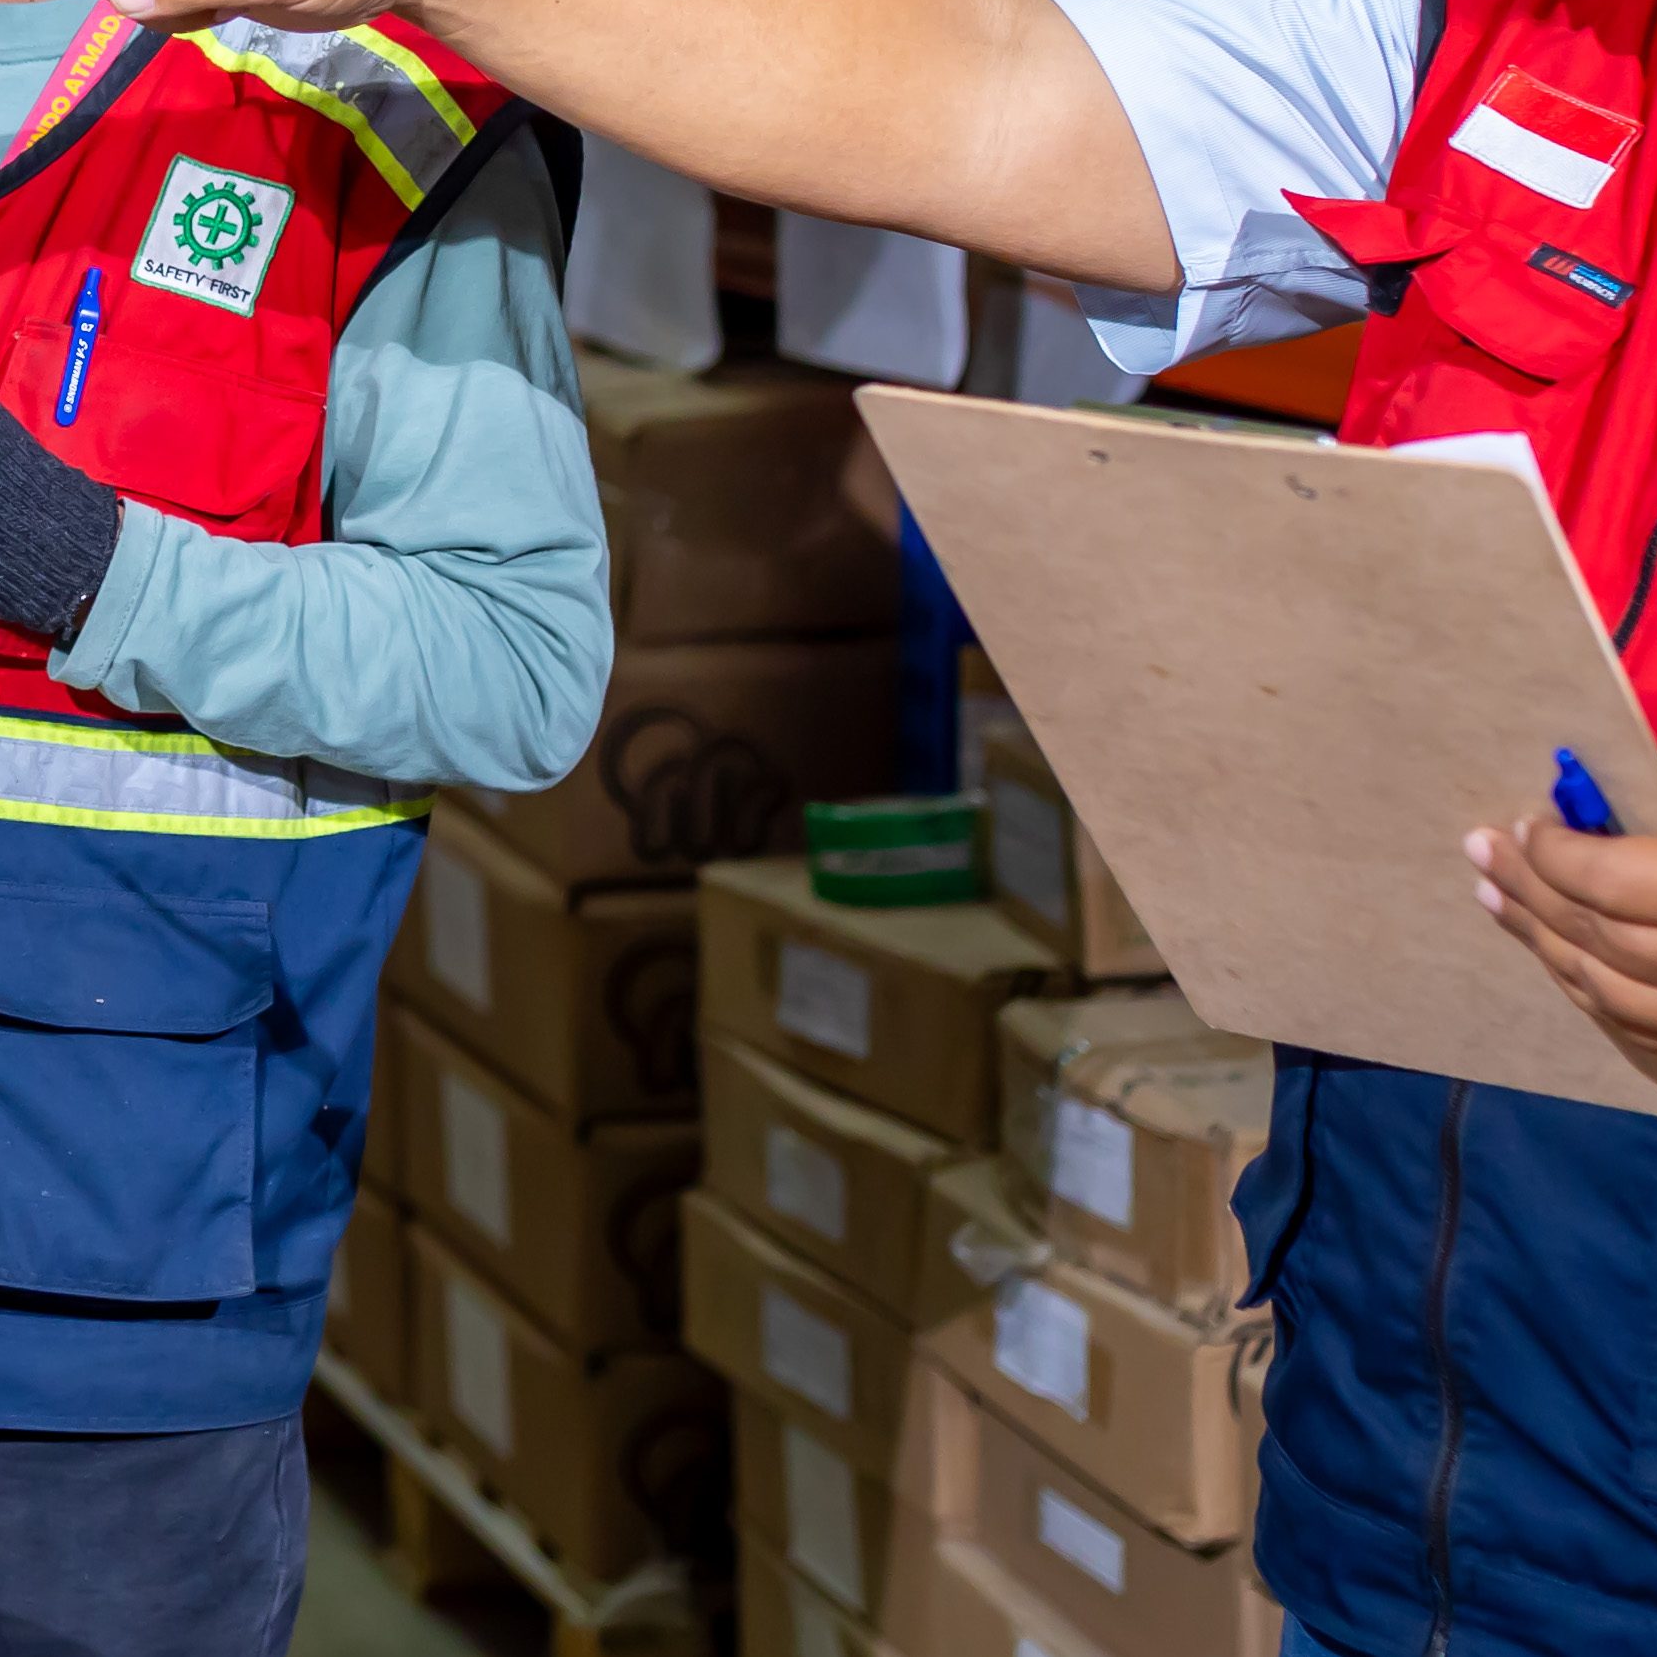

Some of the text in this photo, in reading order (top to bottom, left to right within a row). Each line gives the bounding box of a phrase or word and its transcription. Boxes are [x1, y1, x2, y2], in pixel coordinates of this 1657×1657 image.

[64, 10, 126, 98] ATMAD
[143, 258, 252, 303] SAFETY FIRST
[66, 357, 84, 405] SNOWMAN
